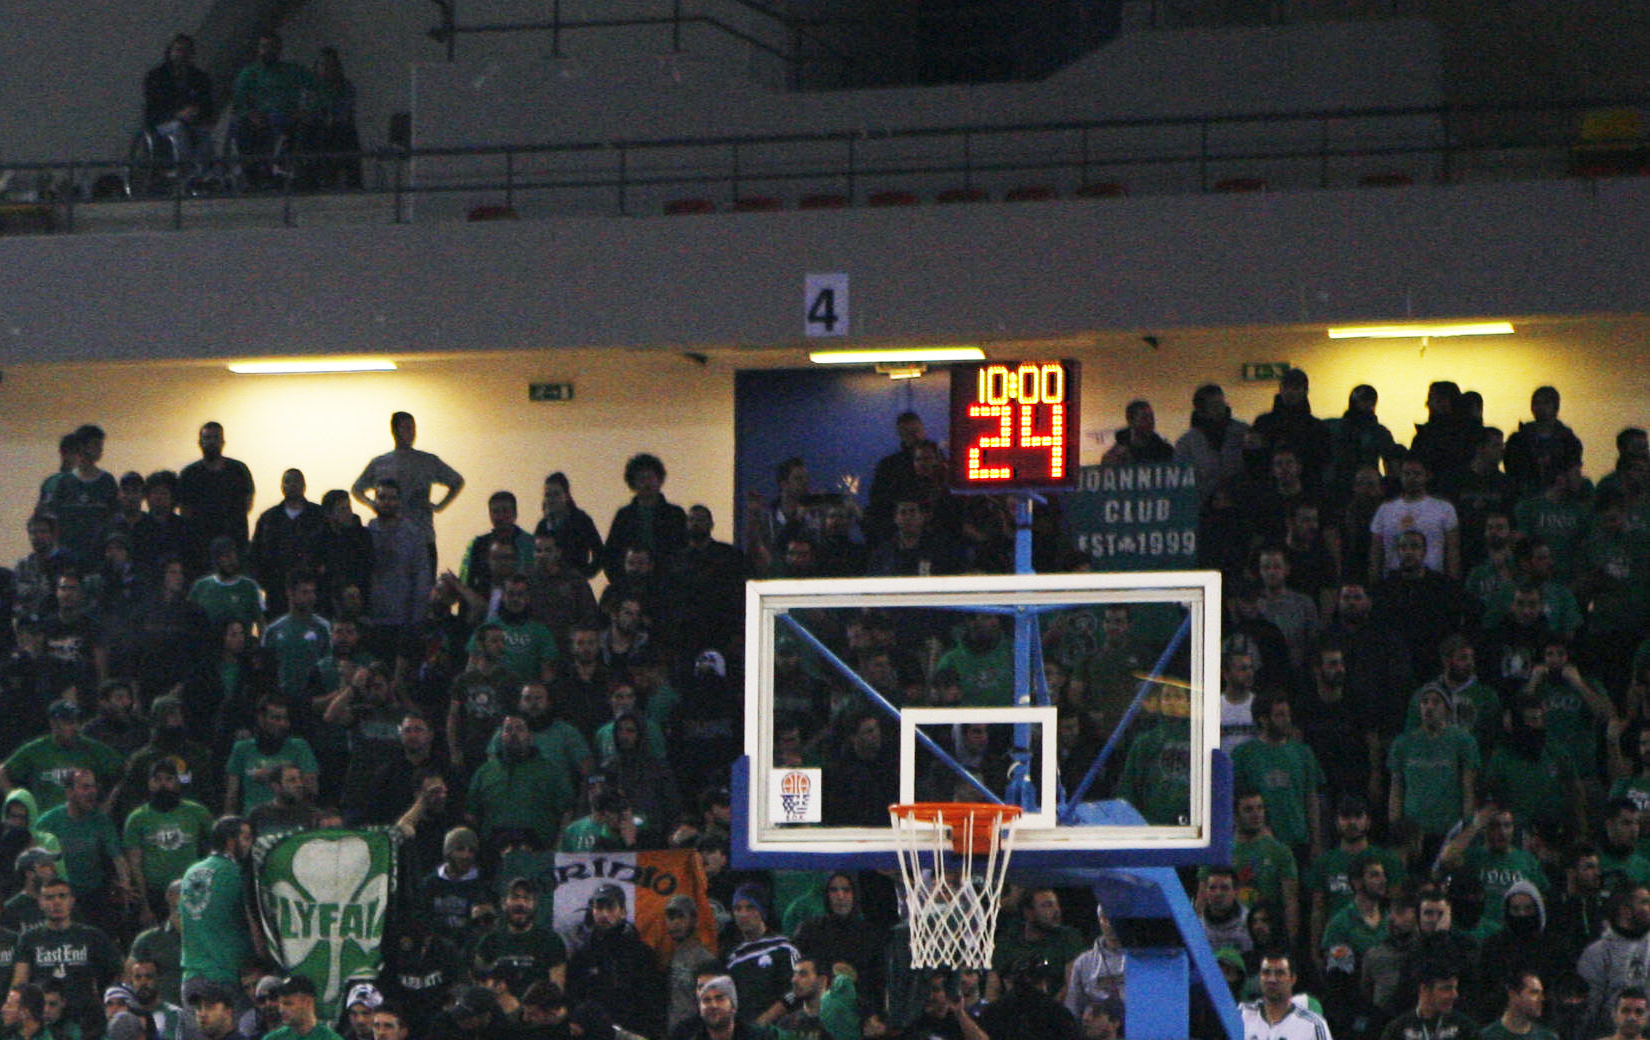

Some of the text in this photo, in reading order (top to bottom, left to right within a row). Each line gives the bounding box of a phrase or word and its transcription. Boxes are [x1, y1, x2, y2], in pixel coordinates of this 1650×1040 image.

[808, 289, 838, 331] 4
[979, 363, 1065, 405] 10:00
[966, 403, 1064, 480] 24
[1105, 500, 1171, 524] CLUB
